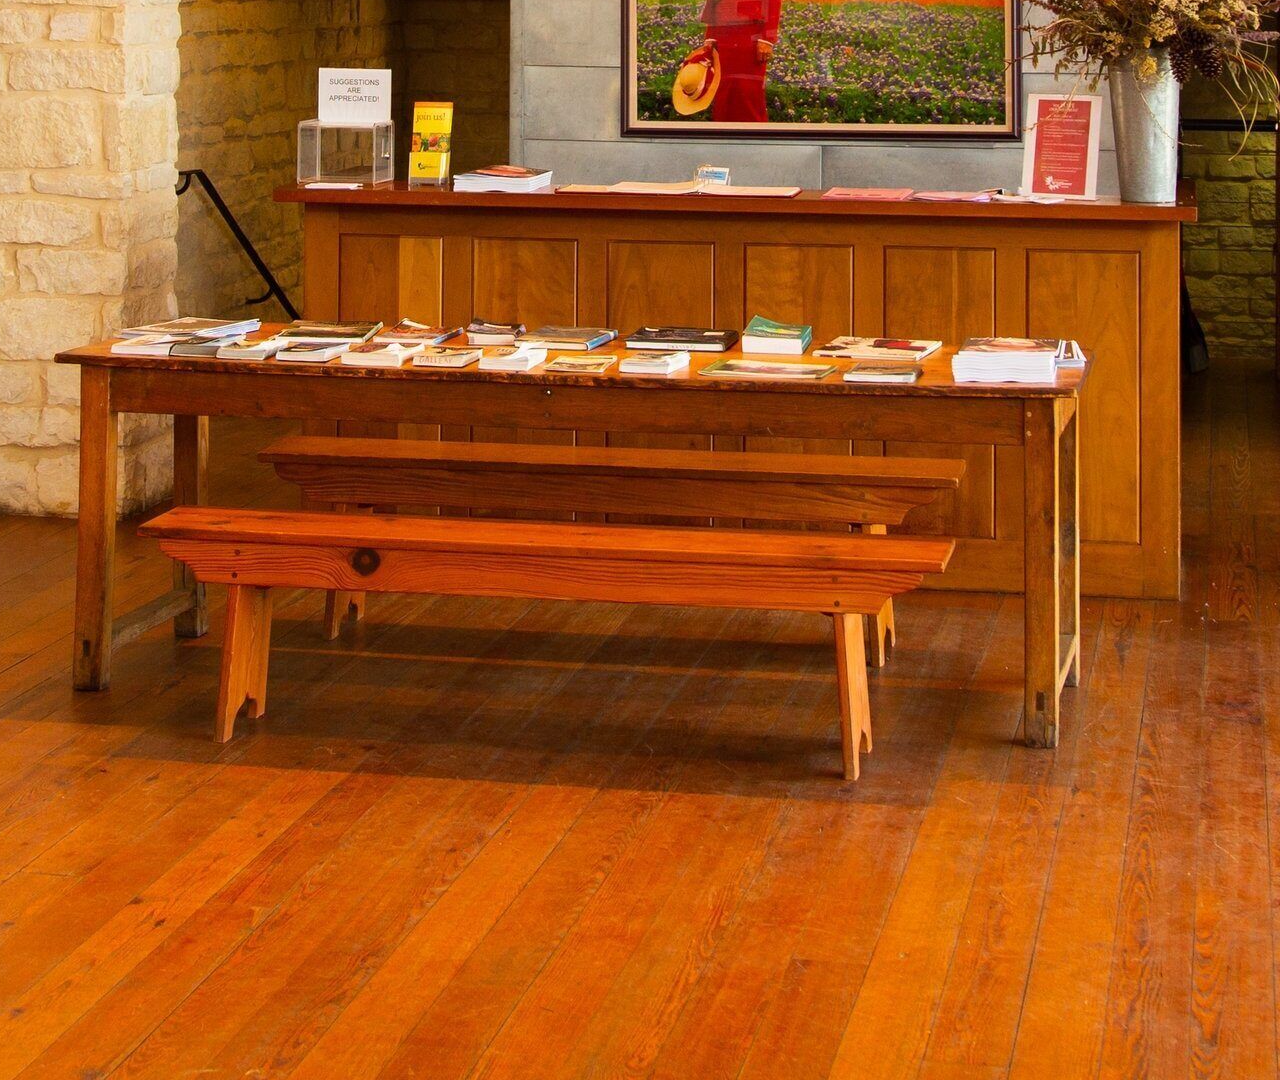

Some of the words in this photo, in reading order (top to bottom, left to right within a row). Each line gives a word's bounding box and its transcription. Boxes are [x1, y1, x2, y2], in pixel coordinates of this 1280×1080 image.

[329, 78, 380, 86] SUGGESTIONS
[328, 94, 380, 103] APPRECIATED!
[416, 113, 431, 123] join
[433, 112, 446, 121] us!
